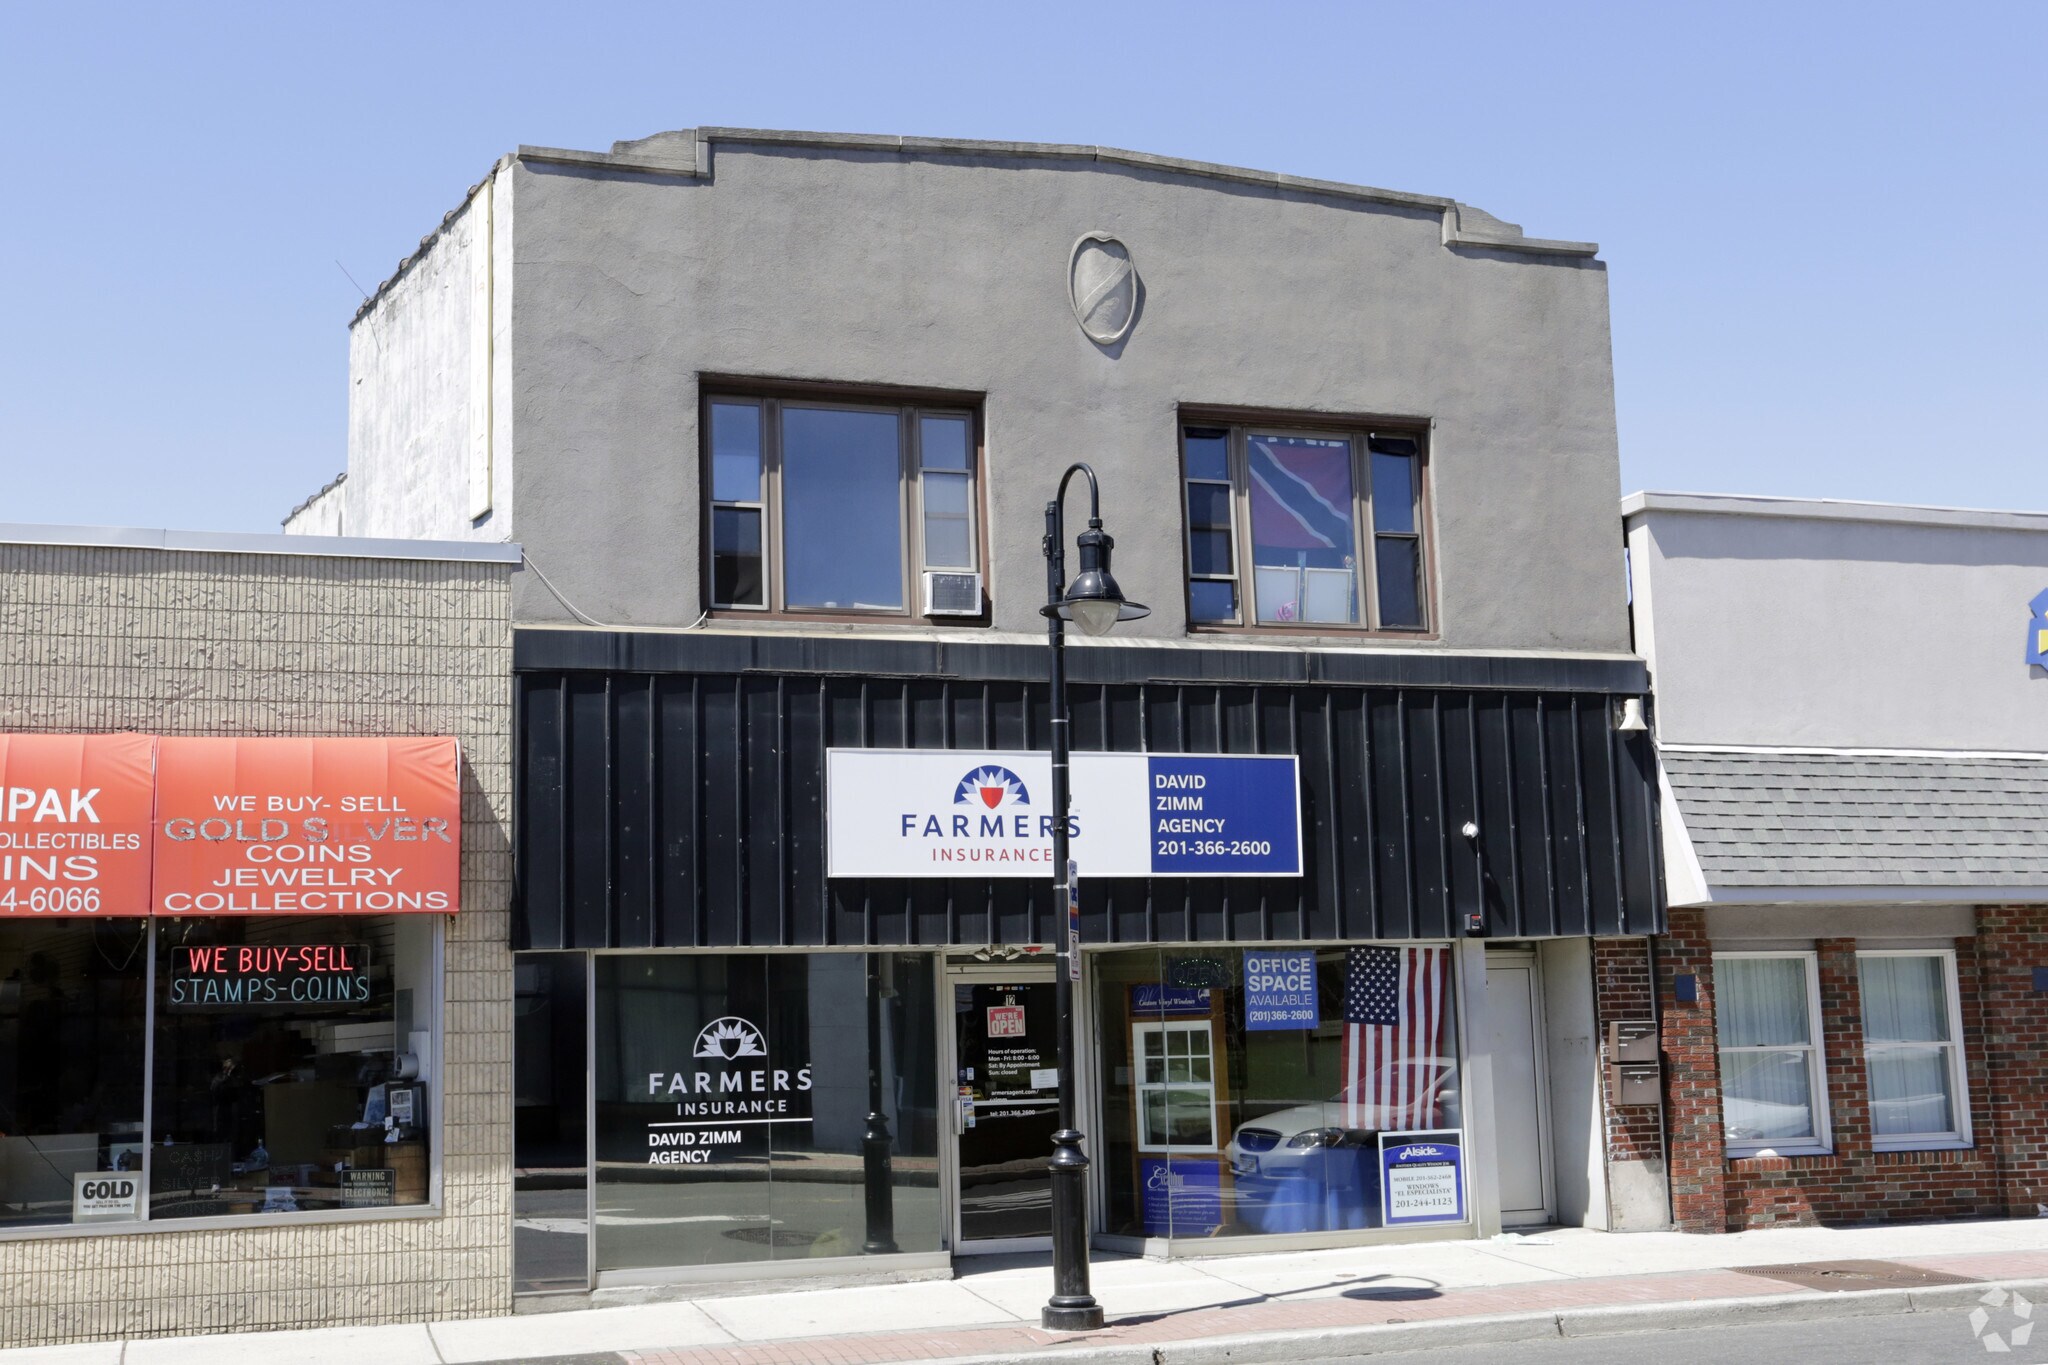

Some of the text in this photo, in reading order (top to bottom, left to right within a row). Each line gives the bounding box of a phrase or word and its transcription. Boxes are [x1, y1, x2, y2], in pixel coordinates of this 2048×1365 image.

[1155, 774, 1206, 789] DAVID
[213, 795, 257, 811] WE
[341, 796, 406, 812] SELL
[1156, 796, 1203, 811] ZIMM
[164, 817, 289, 843] GOLD
[901, 814, 1081, 838] FARMERS
[1157, 818, 1226, 833] AGENCY
[246, 844, 372, 863] COINS
[932, 847, 1053, 862] INSURANCE
[1157, 840, 1271, 856] 201-366-2600
[3, 855, 99, 881] INS
[212, 867, 403, 887] JEWELRY
[0, 886, 101, 913] 4-6066
[163, 891, 449, 911] COLLECTIONS
[189, 946, 353, 973] WE BUY-SELL
[1247, 958, 1311, 973] OFFICE
[172, 976, 368, 1003] STAMPS-COINS
[1248, 975, 1312, 992] SPACE
[1006, 995, 1015, 1006] 12
[1249, 993, 1313, 1006] AVAILABLE
[994, 1012, 1018, 1020] WE'RE
[991, 1019, 1023, 1034] OPEN
[648, 1069, 813, 1095] FARMERS
[677, 1099, 787, 1116] INSURANCE
[648, 1130, 742, 1147] DAVID ZIMM
[648, 1150, 711, 1165] AGENCY
[1400, 1146, 1443, 1160] Alside
[350, 1172, 385, 1181] WARNING
[82, 1180, 134, 1200] GOLD
[345, 1187, 389, 1198] ELECTRONIC
[1395, 1197, 1453, 1208] 201-244-1123
